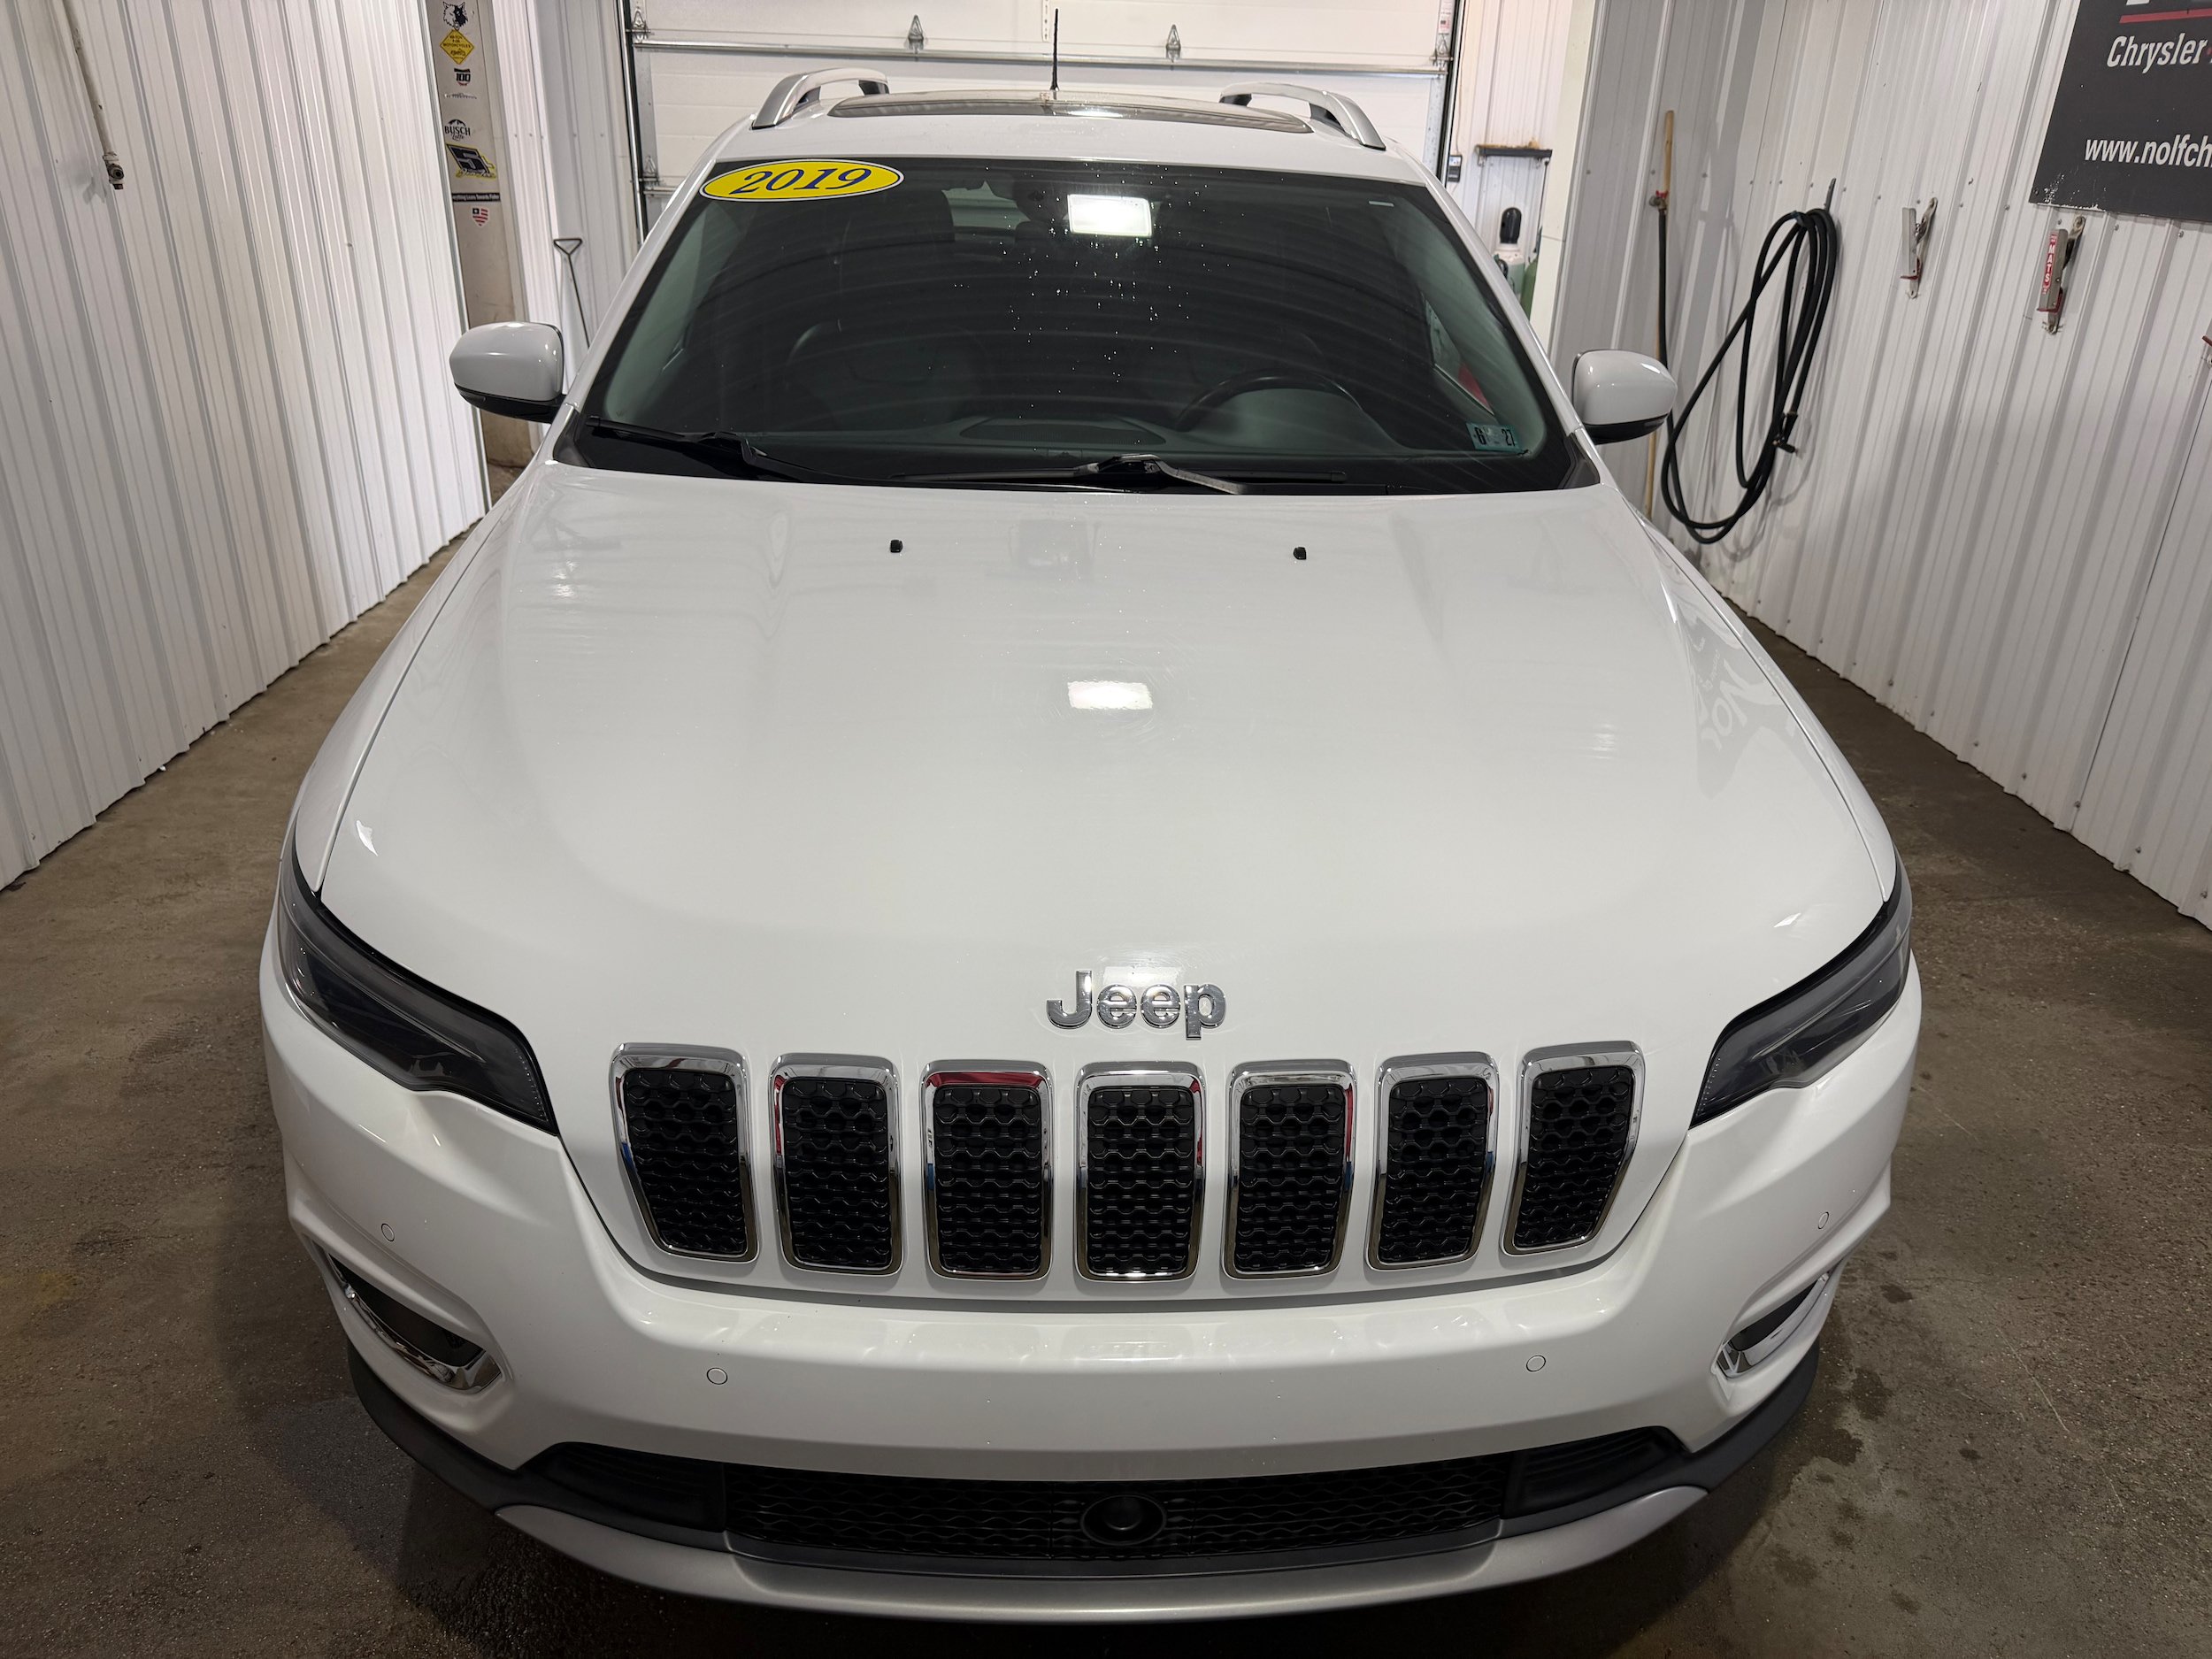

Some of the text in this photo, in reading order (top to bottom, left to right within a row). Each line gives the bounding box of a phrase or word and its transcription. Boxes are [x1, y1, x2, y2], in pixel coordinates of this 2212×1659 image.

[2107, 32, 2208, 74] Chrysler
[444, 126, 471, 137] BUSCH
[2084, 134, 2212, 168] www.nolfch
[728, 167, 873, 196] 2019
[2044, 245, 2055, 283] MATS
[1501, 428, 1516, 447] 27
[1046, 970, 1227, 1041] Jeep
